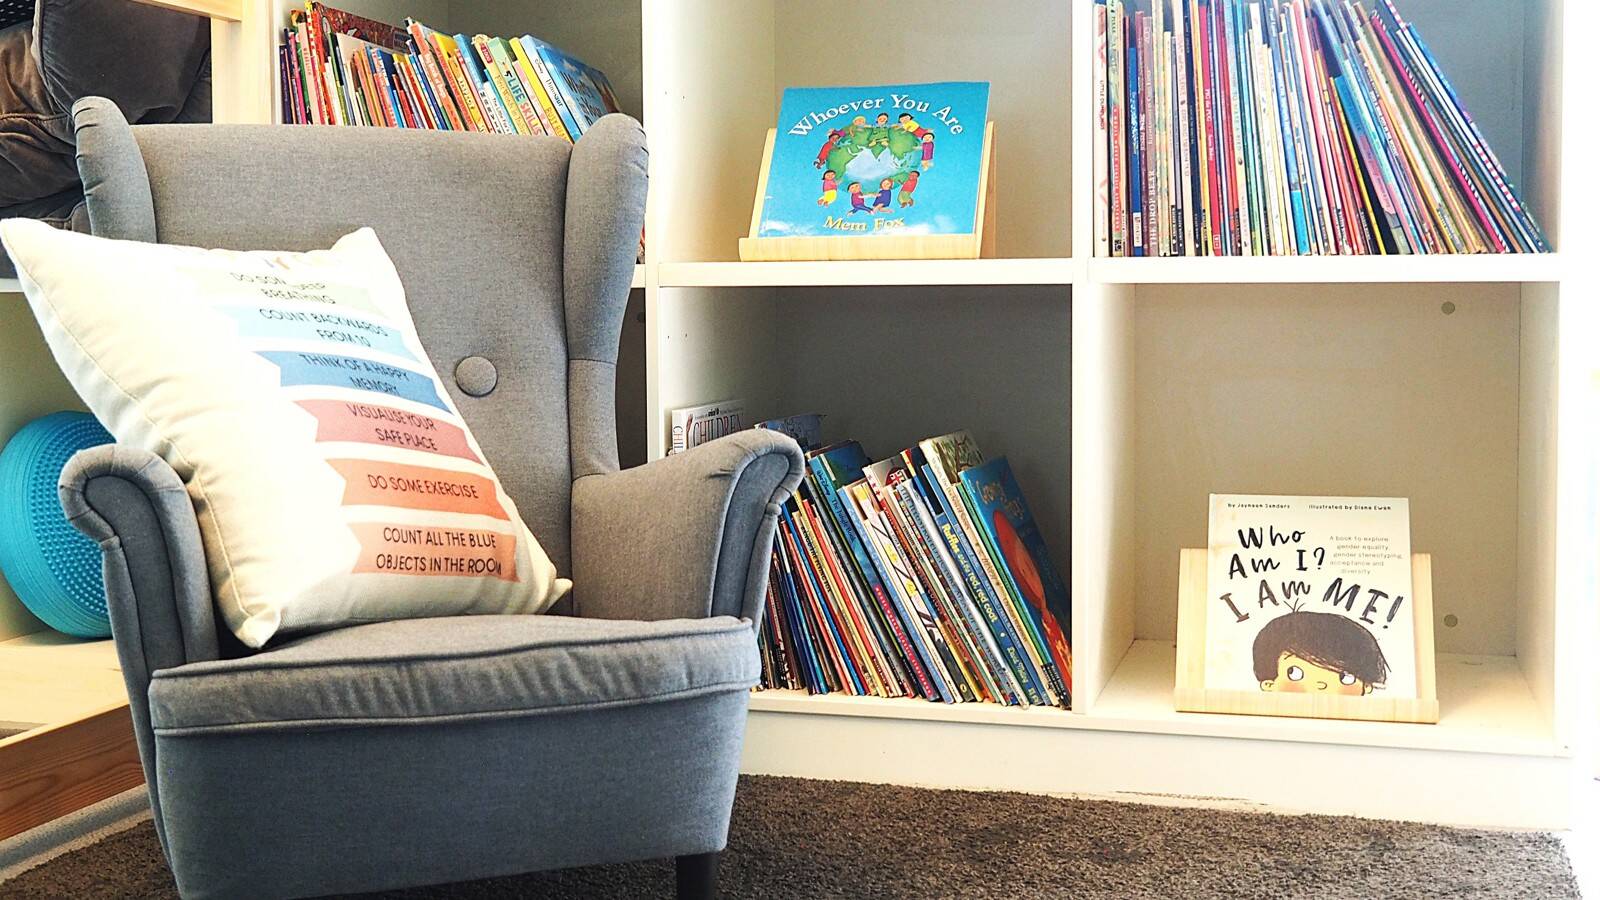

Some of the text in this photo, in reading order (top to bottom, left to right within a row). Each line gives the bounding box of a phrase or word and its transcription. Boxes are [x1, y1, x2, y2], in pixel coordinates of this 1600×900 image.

[508, 77, 542, 135] LIFE SKILLS
[543, 78, 566, 107] Dinosaur
[787, 94, 964, 137] Whoever You Are
[1147, 170, 1157, 246] THE DROP BEAR
[824, 215, 906, 231] Mem Fox
[256, 275, 286, 284] SOM
[261, 288, 336, 304] BREATHING
[259, 309, 388, 337] COUNT BACKWARDS
[316, 329, 371, 347] FROM 10
[299, 354, 410, 381] THINK OF A HAPPY
[350, 376, 400, 394] MEMORY
[346, 403, 436, 431] VISUALISE YOUR
[375, 428, 438, 451] SAFE PLACE
[367, 474, 479, 499] DO SOME EXERCISE
[819, 478, 832, 496] Disney
[830, 498, 840, 510] The
[835, 509, 849, 528] Jungle
[384, 527, 496, 548] COUNT ALL THE BLUE
[900, 487, 911, 503] THE
[908, 504, 938, 554] ILLUSTRATED
[936, 555, 956, 588] PICTURE
[1237, 525, 1305, 549] Who
[376, 553, 427, 571] OBJECTS
[430, 557, 443, 572] IN
[444, 557, 464, 572] THE
[939, 522, 963, 554] Ruffles
[966, 571, 981, 589] red,
[975, 586, 989, 603] red
[982, 600, 999, 622] coat
[1228, 547, 1325, 580] Am I?
[1220, 577, 1404, 629] I Am ME!
